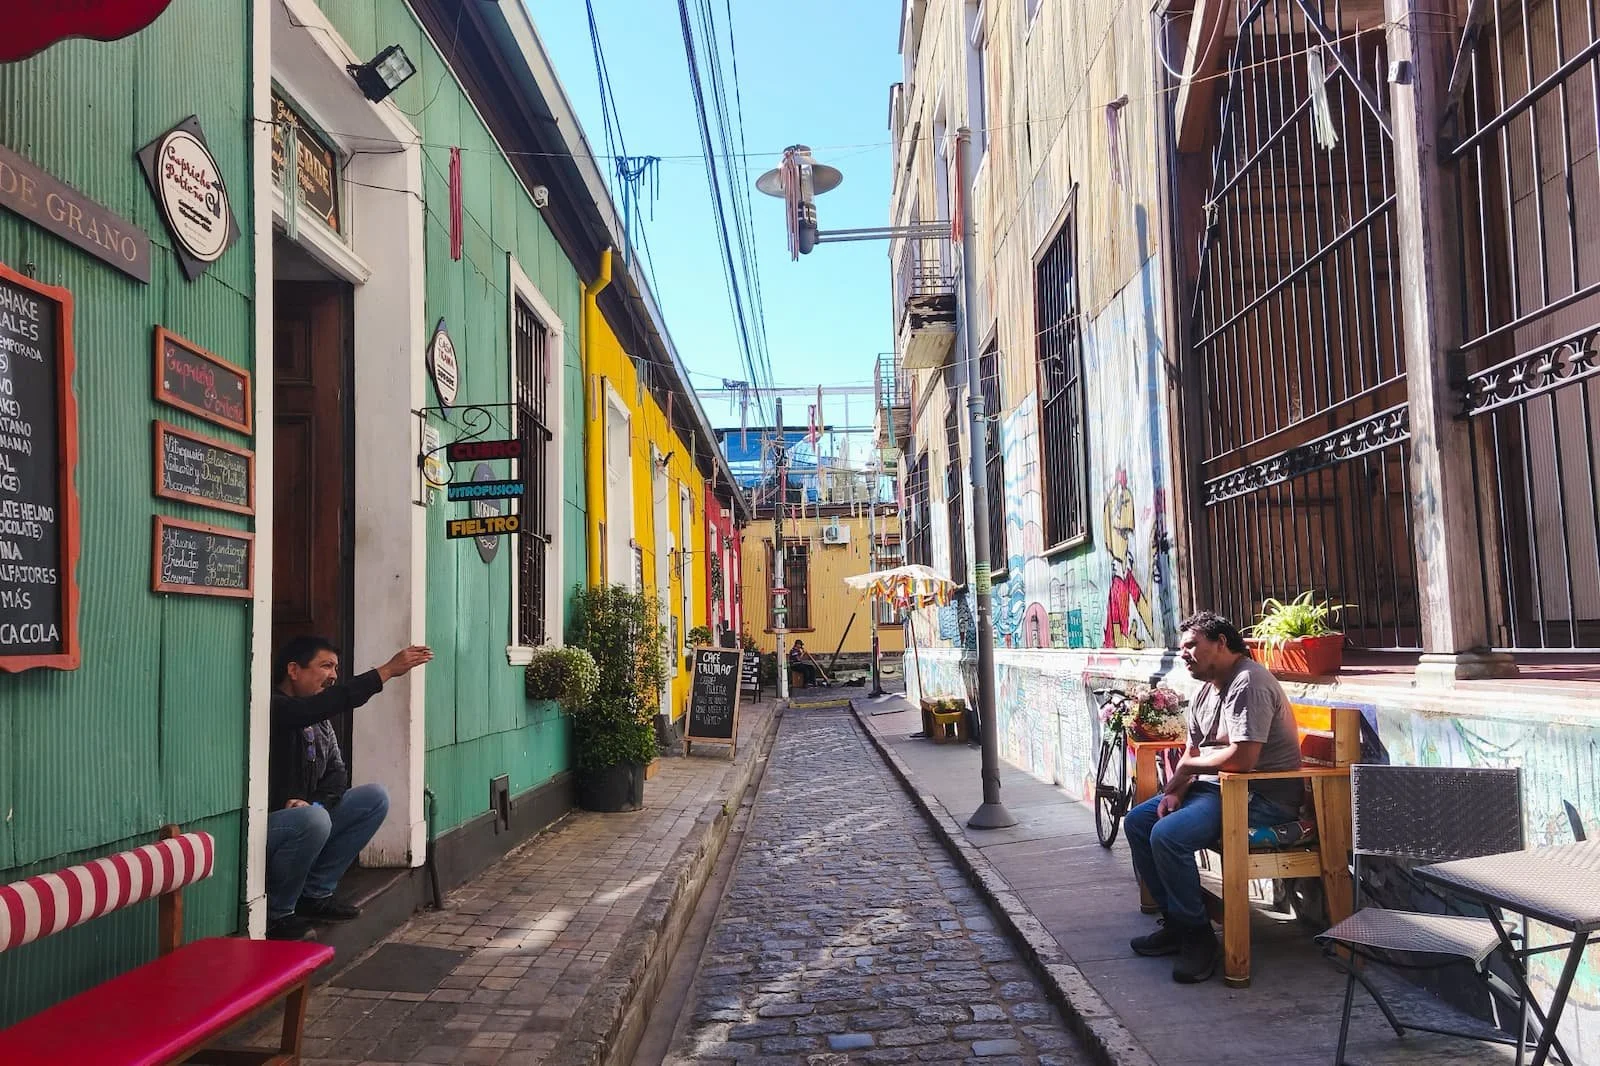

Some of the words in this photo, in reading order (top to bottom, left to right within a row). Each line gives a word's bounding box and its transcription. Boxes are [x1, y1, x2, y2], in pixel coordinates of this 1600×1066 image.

[0, 161, 37, 208] DE
[46, 193, 136, 261] GRANO
[0, 312, 38, 341] ALES
[449, 484, 524, 498] VITROFUSION
[21, 503, 54, 523] HELADO
[451, 516, 518, 536] FIELTRO
[1, 588, 32, 609] MÁS
